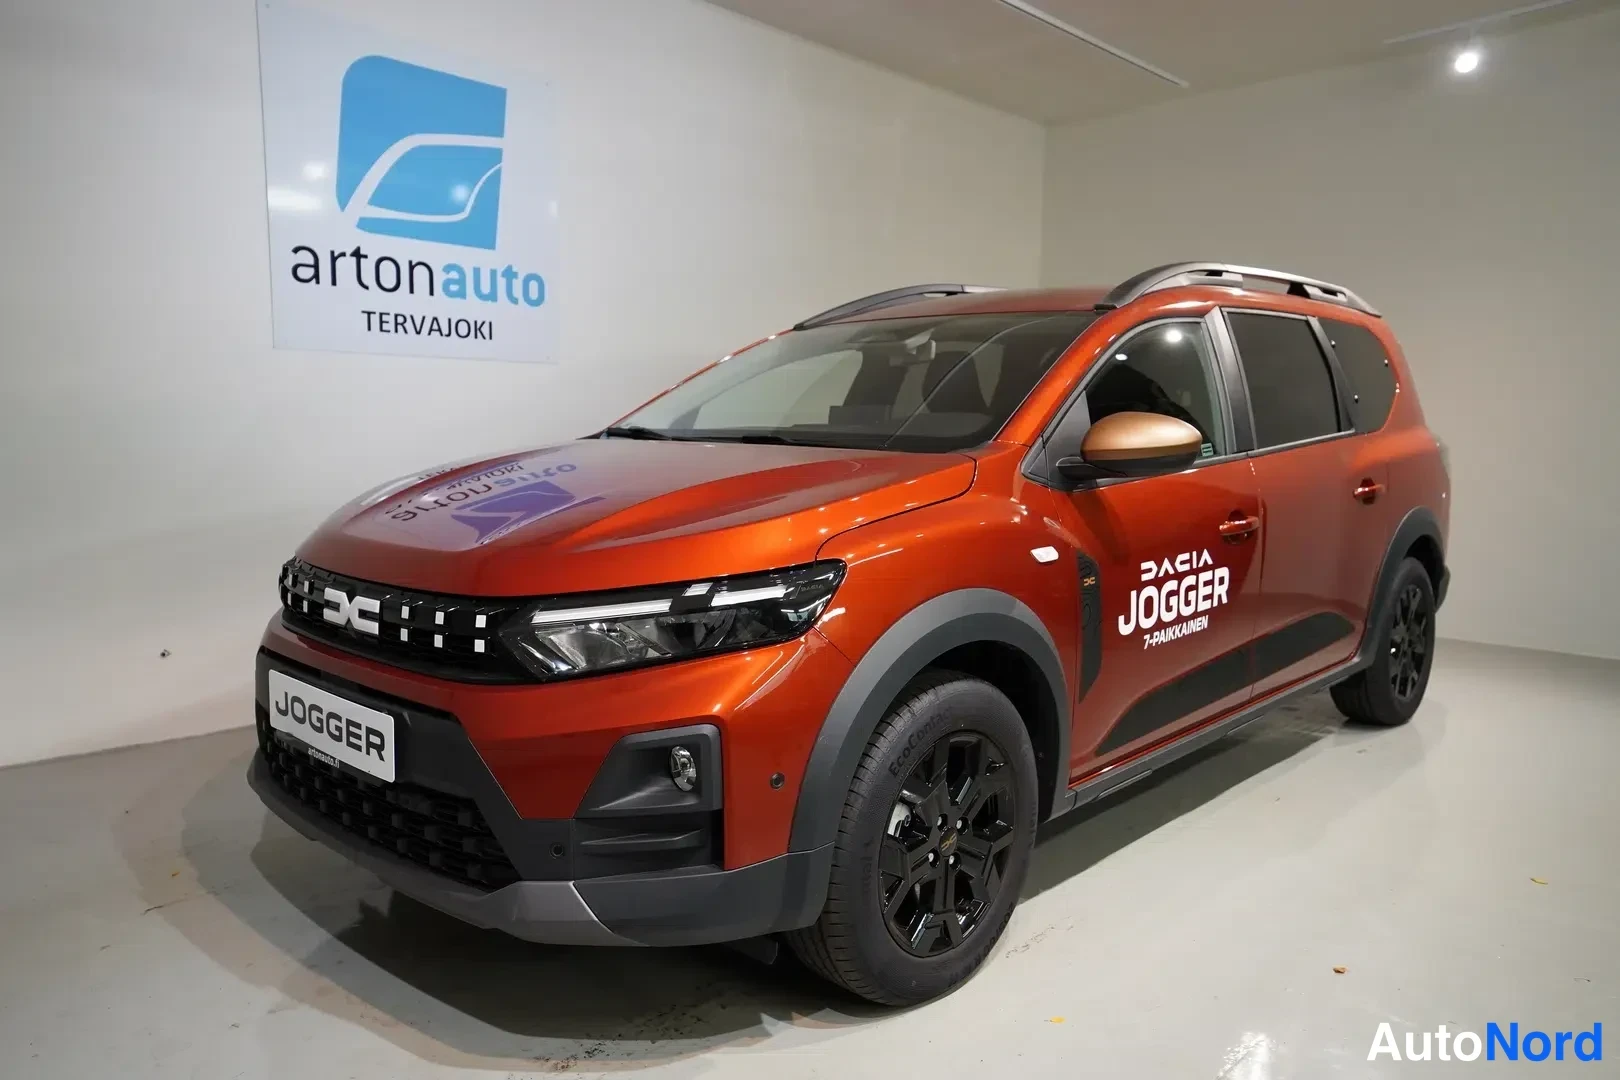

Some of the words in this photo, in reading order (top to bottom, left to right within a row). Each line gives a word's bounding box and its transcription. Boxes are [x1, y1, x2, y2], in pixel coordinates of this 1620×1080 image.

[291, 245, 545, 307] artonauto
[361, 310, 493, 340] TERVAJOKI
[1140, 549, 1213, 582] DACIA
[1118, 566, 1230, 636] JOGGER
[1143, 615, 1208, 650] 7-PAIKKAINEN
[275, 691, 386, 762] JOGGER
[308, 747, 340, 768] artonauto.fi
